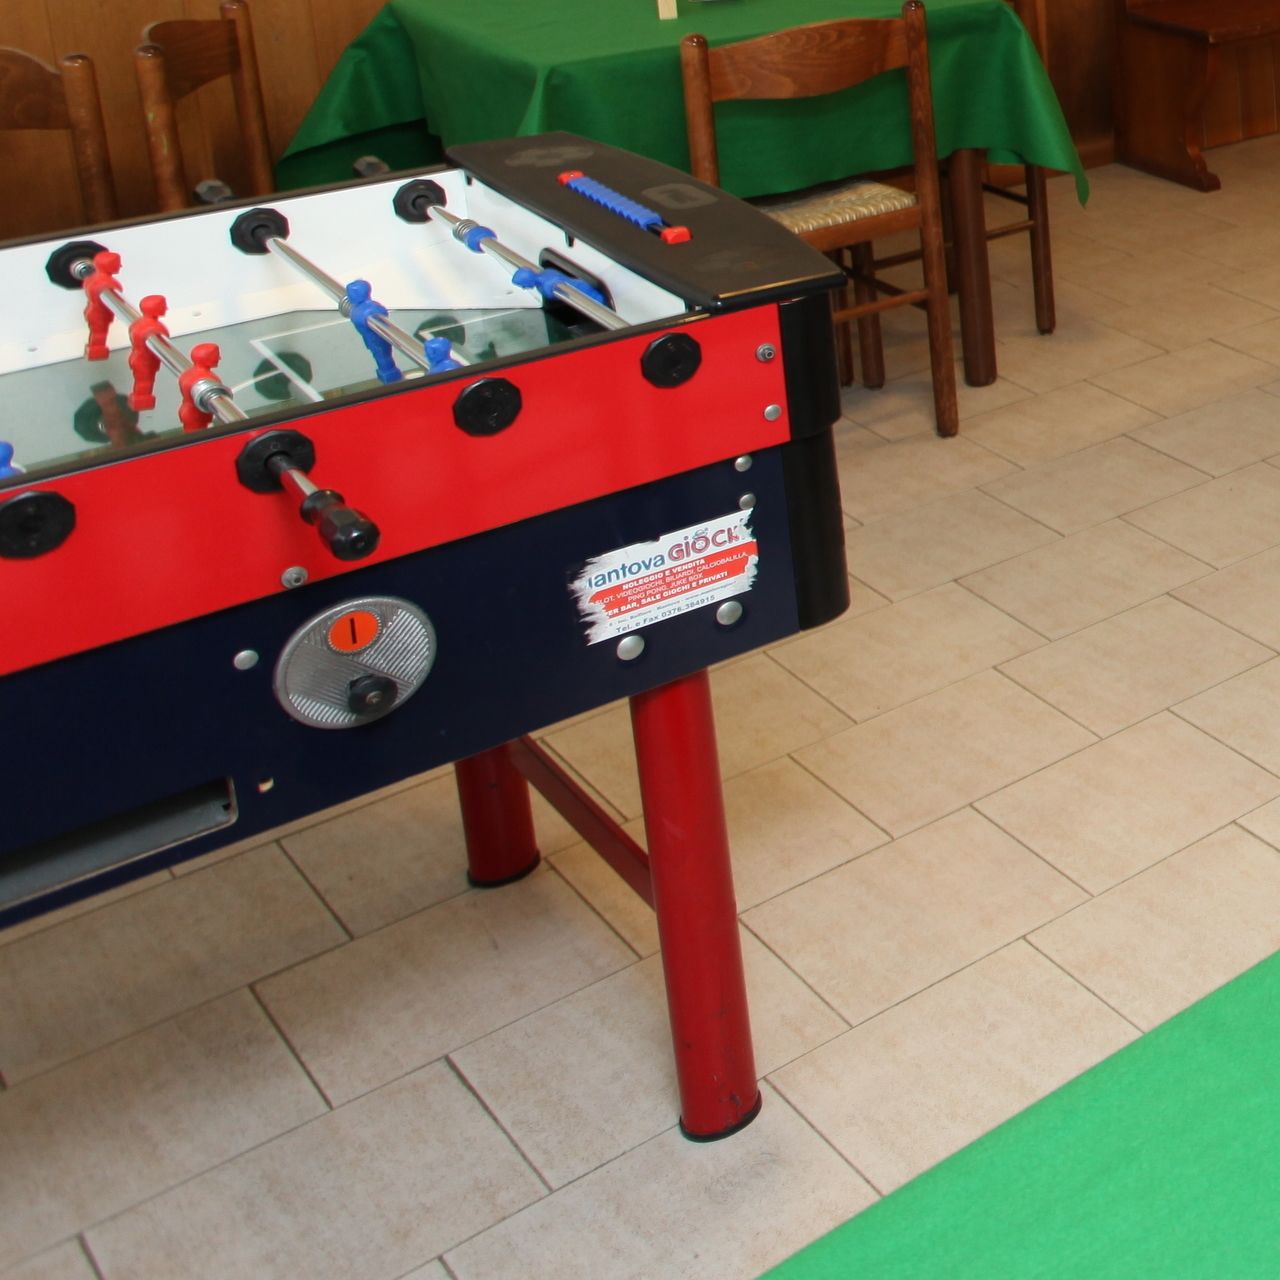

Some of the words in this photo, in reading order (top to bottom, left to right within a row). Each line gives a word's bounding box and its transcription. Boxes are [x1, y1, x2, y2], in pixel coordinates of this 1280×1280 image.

[622, 573, 663, 590] NOLEGGIO
[672, 559, 705, 573] VENDITA
[627, 593, 645, 602] PING
[670, 577, 688, 588] JUKE
[689, 572, 703, 581] BOX
[620, 602, 639, 612] BAR,
[641, 594, 661, 604] SALE
[663, 584, 690, 597] GIOCHI
[698, 571, 728, 585] PRIVATI
[616, 624, 632, 633] Tel.
[644, 616, 658, 624] Fax
